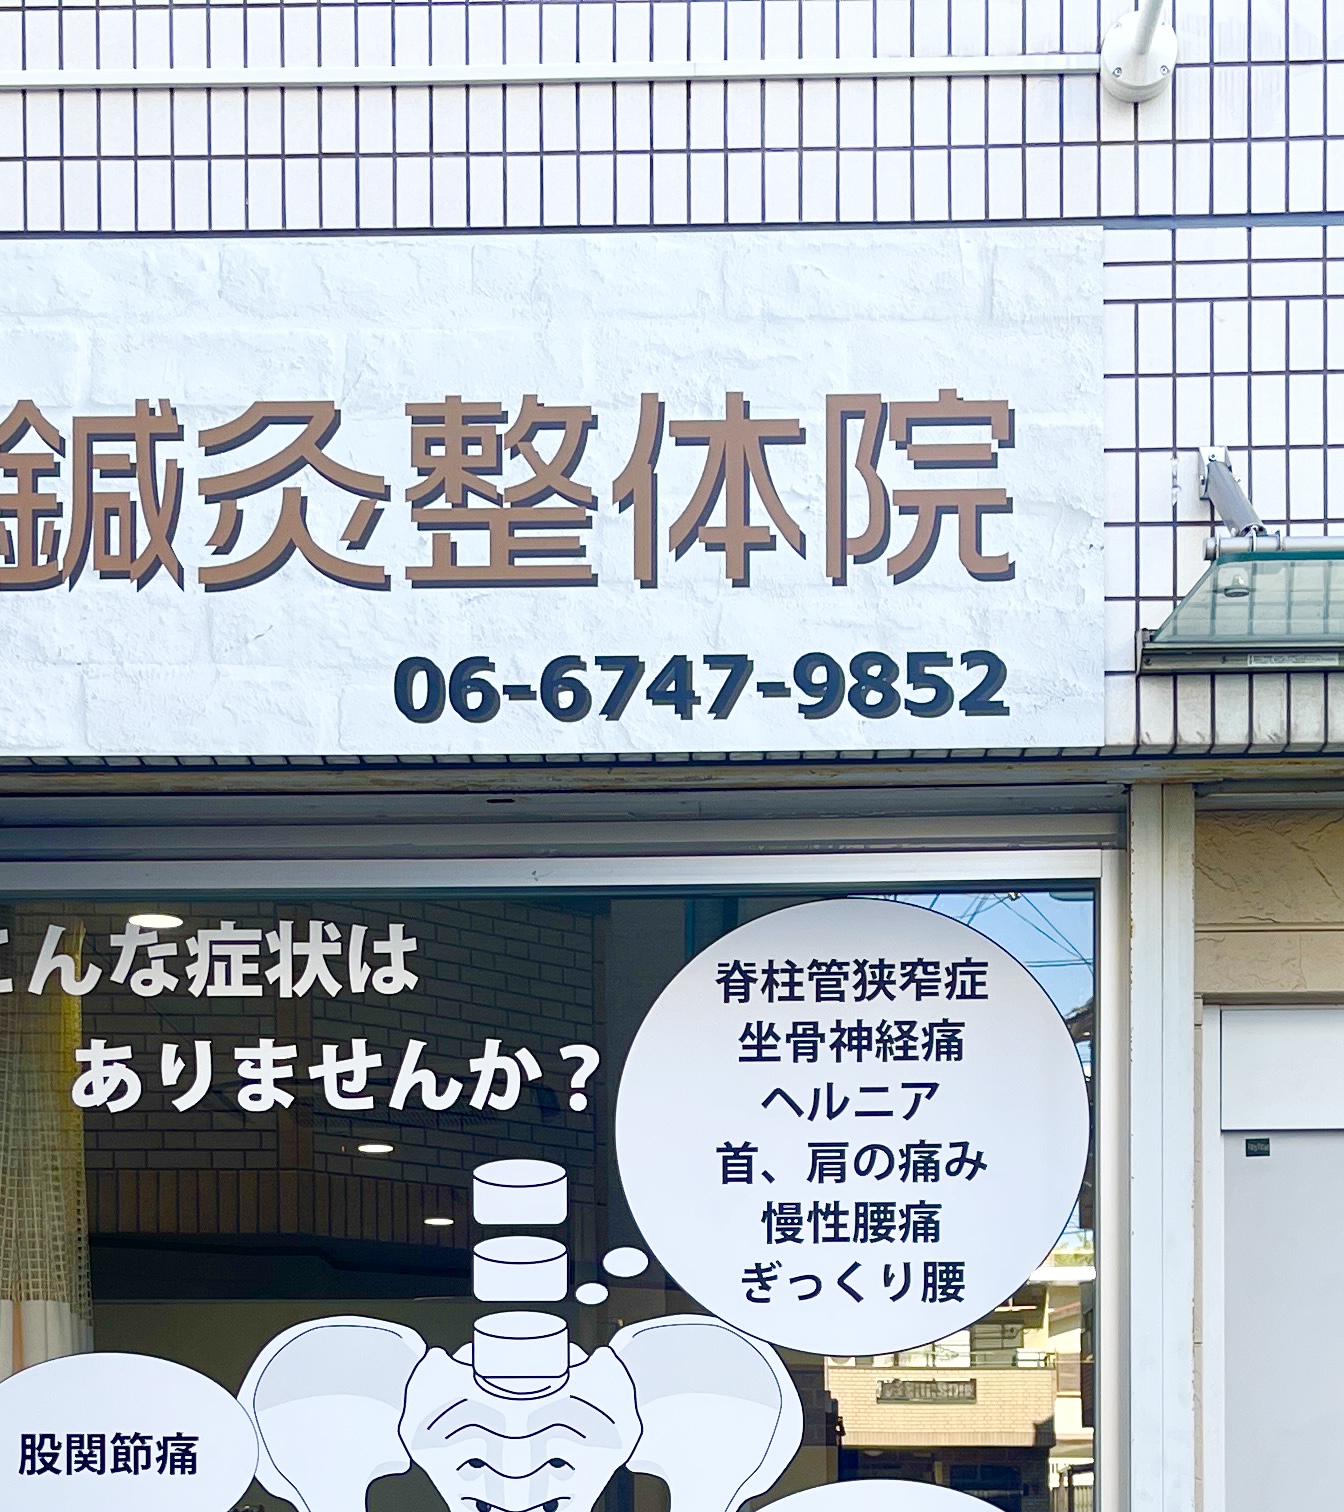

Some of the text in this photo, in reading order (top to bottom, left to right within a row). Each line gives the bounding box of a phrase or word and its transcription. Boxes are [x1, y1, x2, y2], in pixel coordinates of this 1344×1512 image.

[394, 650, 1010, 723] 06-6747-9852
[715, 957, 989, 1003] 脊柱管狭窄症
[737, 1019, 966, 1064] 坐骨神経痛
[71, 1038, 601, 1113] ありませんか？
[760, 1080, 940, 1122] ヘルニア
[715, 1140, 988, 1185] 首、肩の痛み
[760, 1200, 943, 1245] 慢性腰痛
[740, 1260, 966, 1303] ぎっくり腰
[18, 1431, 199, 1477] 股関節痛
